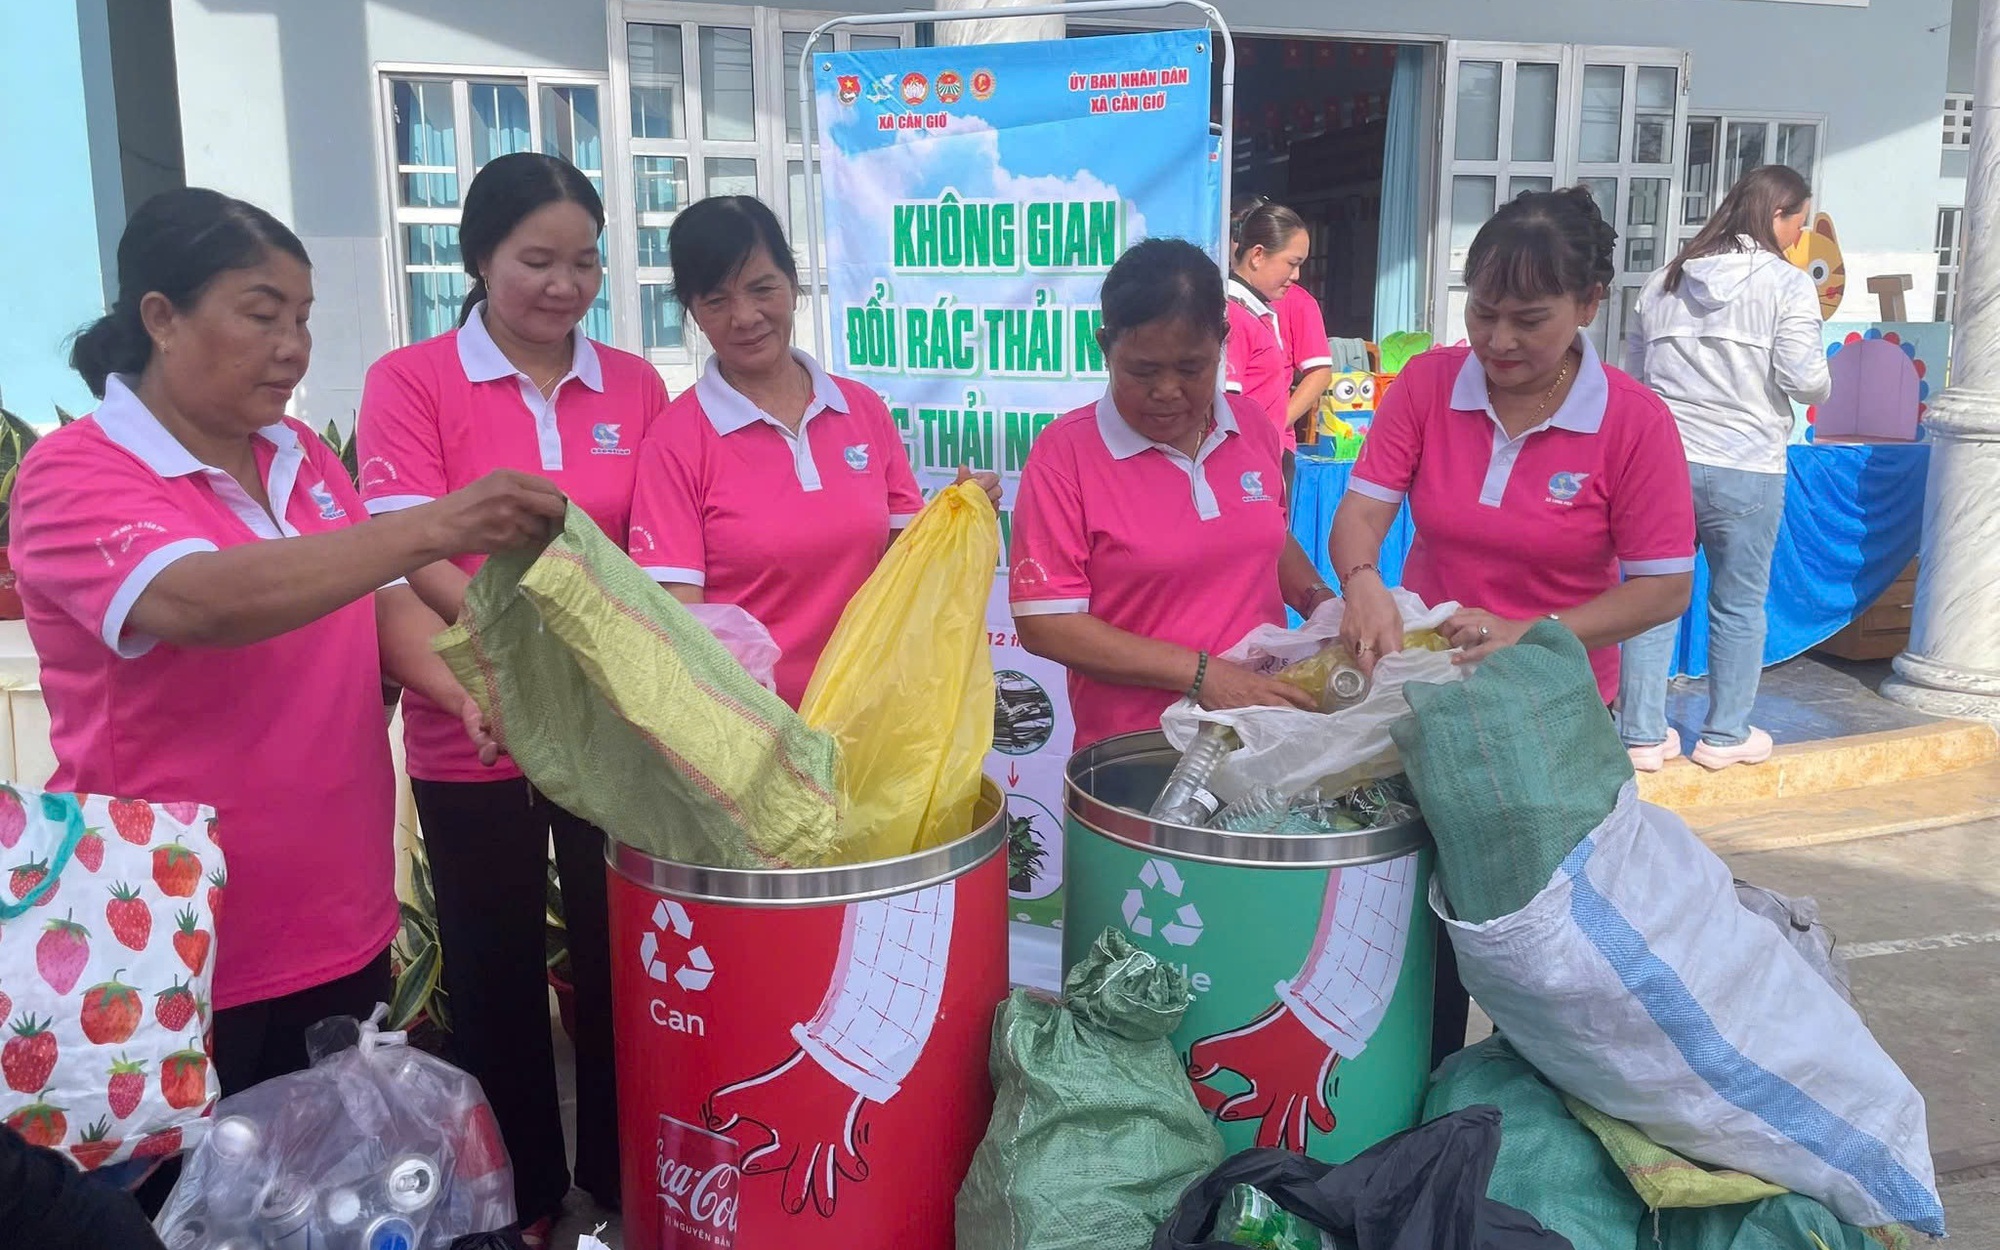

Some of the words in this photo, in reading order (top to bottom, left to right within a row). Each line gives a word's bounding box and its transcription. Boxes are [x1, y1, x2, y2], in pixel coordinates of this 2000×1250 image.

[1090, 74, 1117, 90] BAN
[1121, 69, 1157, 88] NHÂN
[1161, 67, 1188, 85] DÂN
[893, 191, 1016, 267] KHÔNG
[1026, 200, 1117, 267] GIAN
[846, 282, 898, 367] ĐỔI
[905, 296, 975, 370] RÁC
[983, 288, 1064, 372] THẢI
[918, 390, 994, 471] THẢI
[987, 632, 1006, 646] 12
[650, 998, 705, 1037] Can
